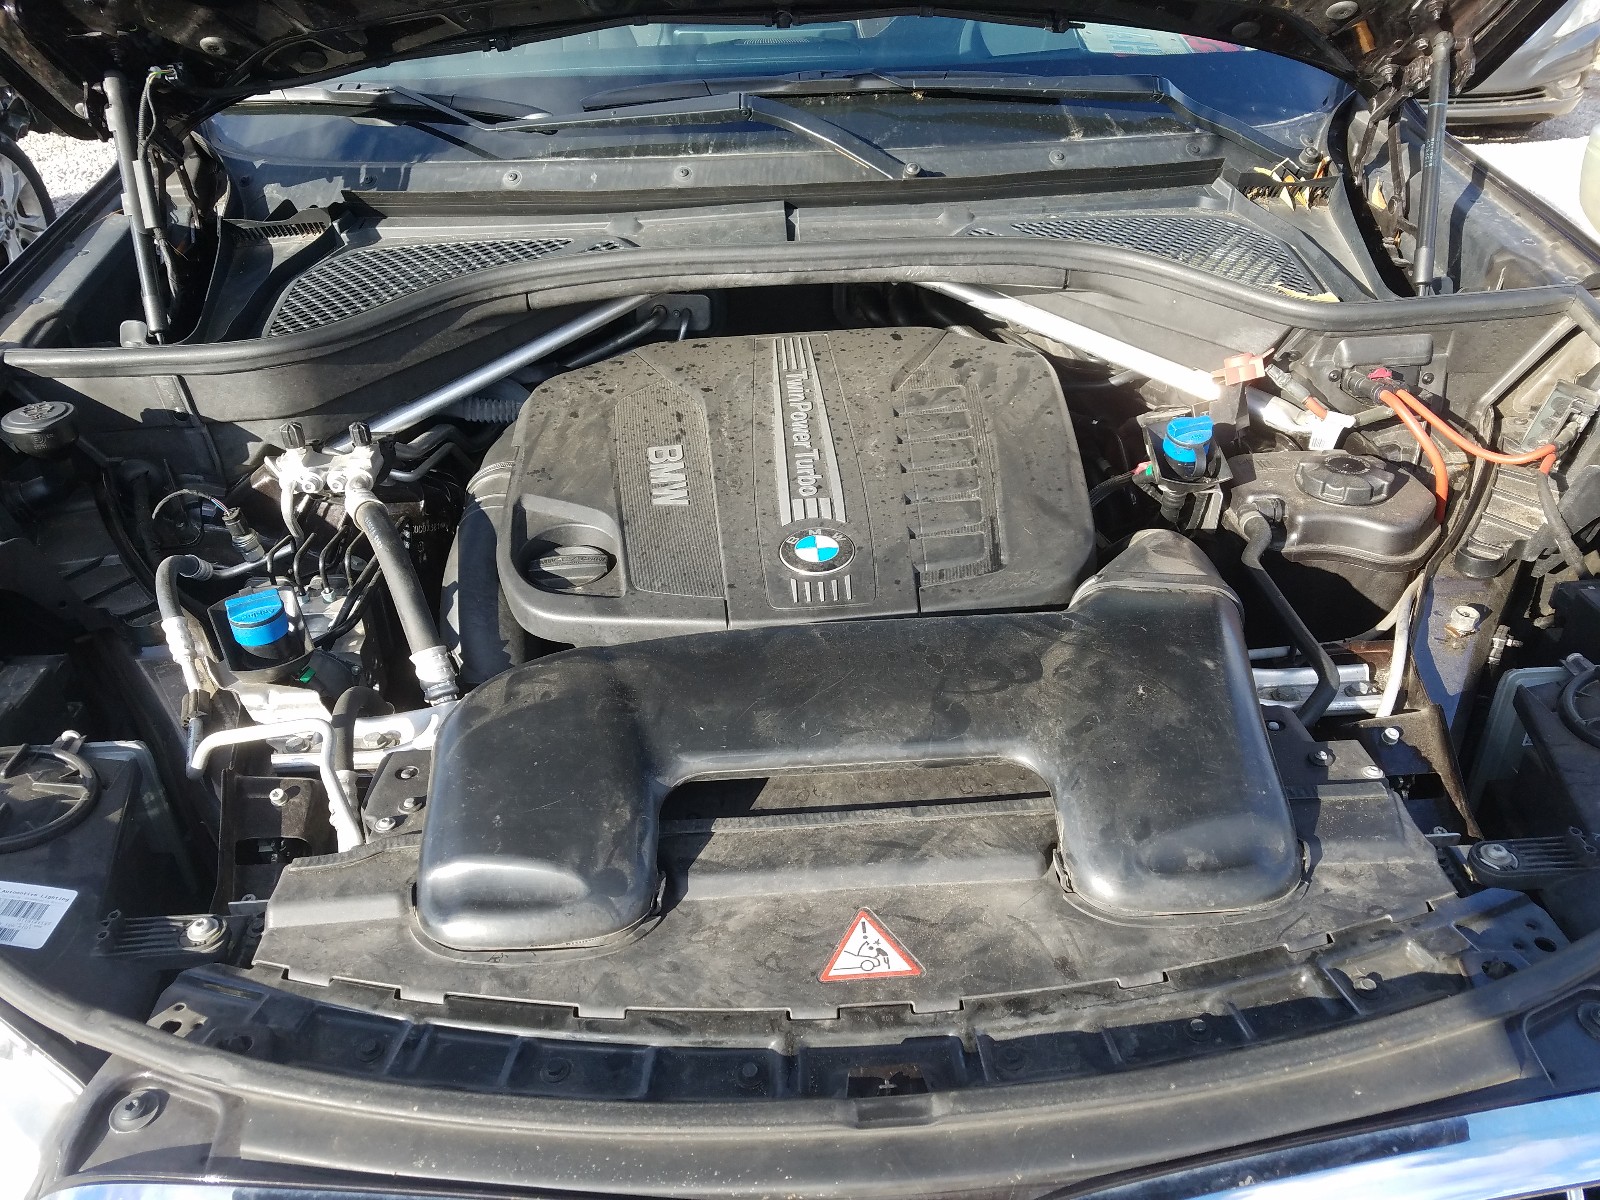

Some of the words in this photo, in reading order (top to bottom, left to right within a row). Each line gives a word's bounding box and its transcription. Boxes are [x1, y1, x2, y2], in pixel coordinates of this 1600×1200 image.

[785, 370, 814, 449] TwinPower
[646, 444, 691, 506] BMW
[794, 448, 823, 497] Turbo
[786, 528, 847, 545] BMW
[40, 894, 70, 902] Lighting
